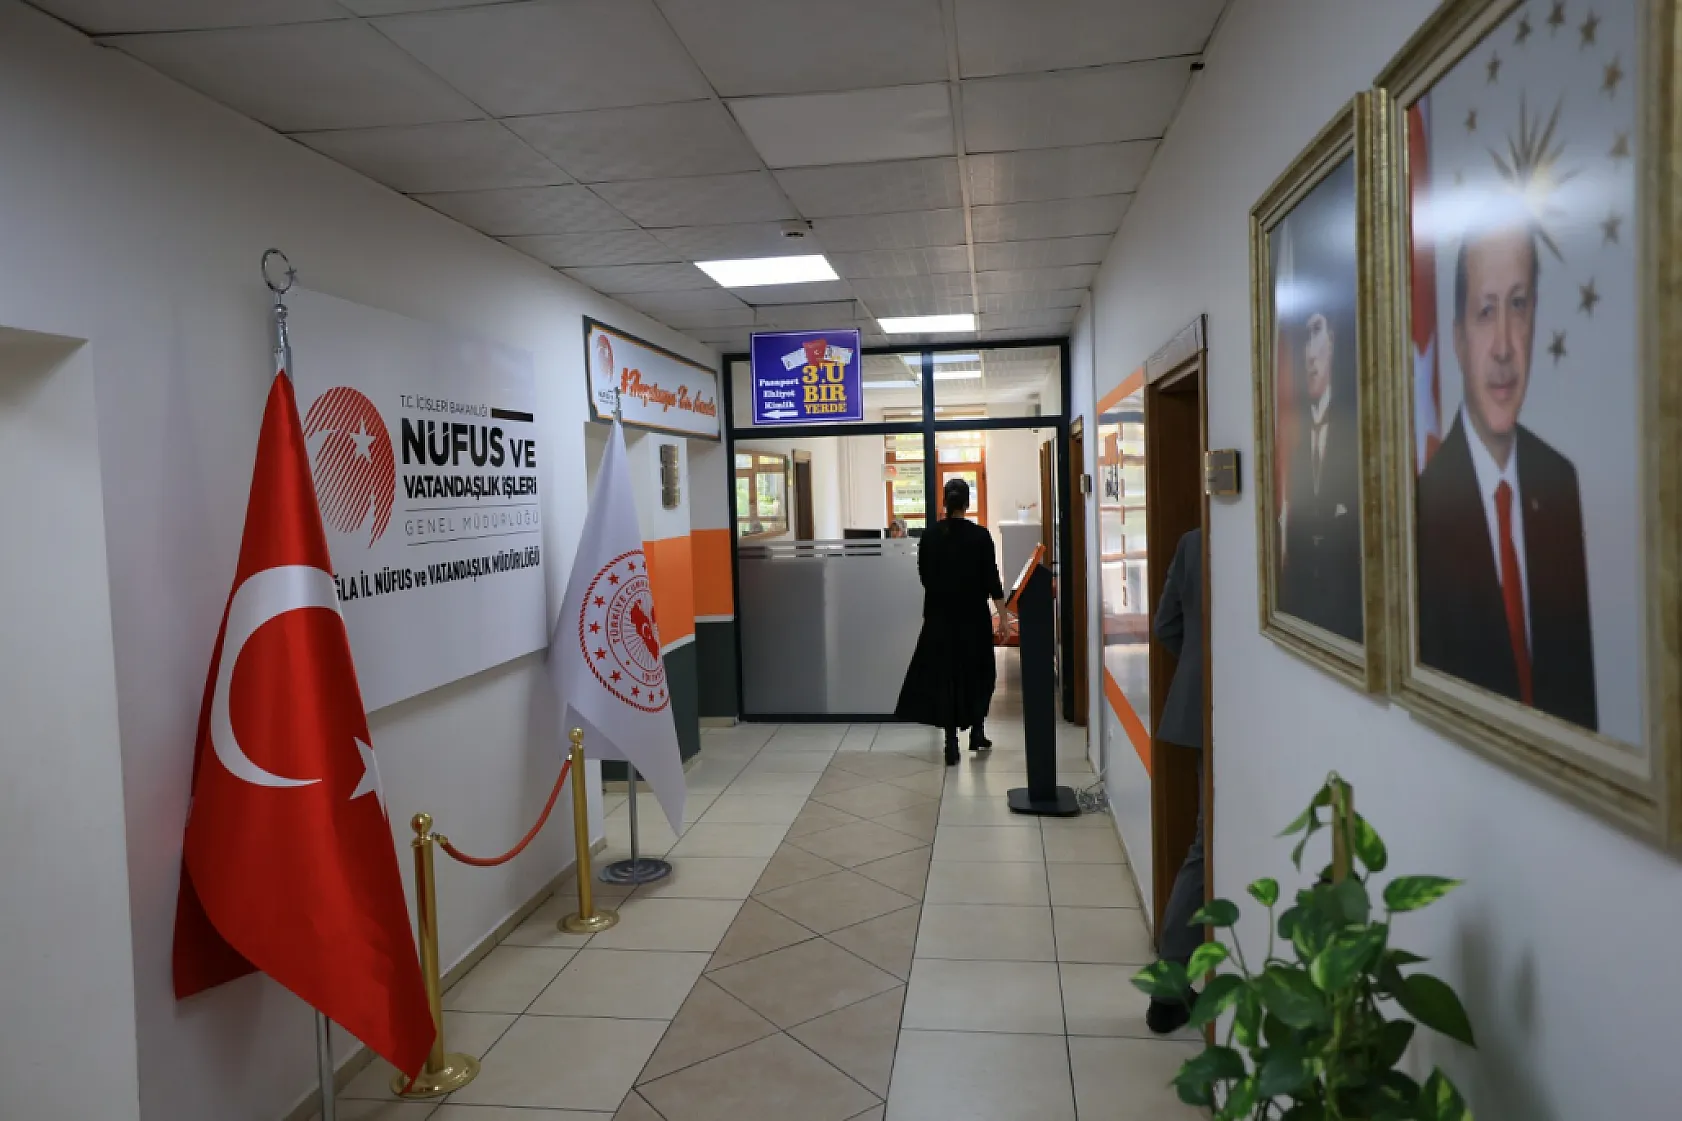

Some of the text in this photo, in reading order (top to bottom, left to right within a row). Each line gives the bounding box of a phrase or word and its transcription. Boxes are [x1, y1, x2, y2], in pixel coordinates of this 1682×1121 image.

[764, 401, 795, 409] Kimlik
[804, 404, 847, 414] YERDE
[401, 417, 537, 468] NÜFUS VE
[403, 475, 537, 500] VATANDAŞLIK İŞLERİ
[404, 509, 539, 536] GENEL MÜDÜRLÜĞÜ
[360, 570, 373, 598] İL
[374, 566, 412, 595] NÜFUS
[414, 571, 426, 588] ve
[427, 555, 491, 585] VATANDAŞLIK
[491, 546, 540, 573] MÜDÜRLÜĞÜ
